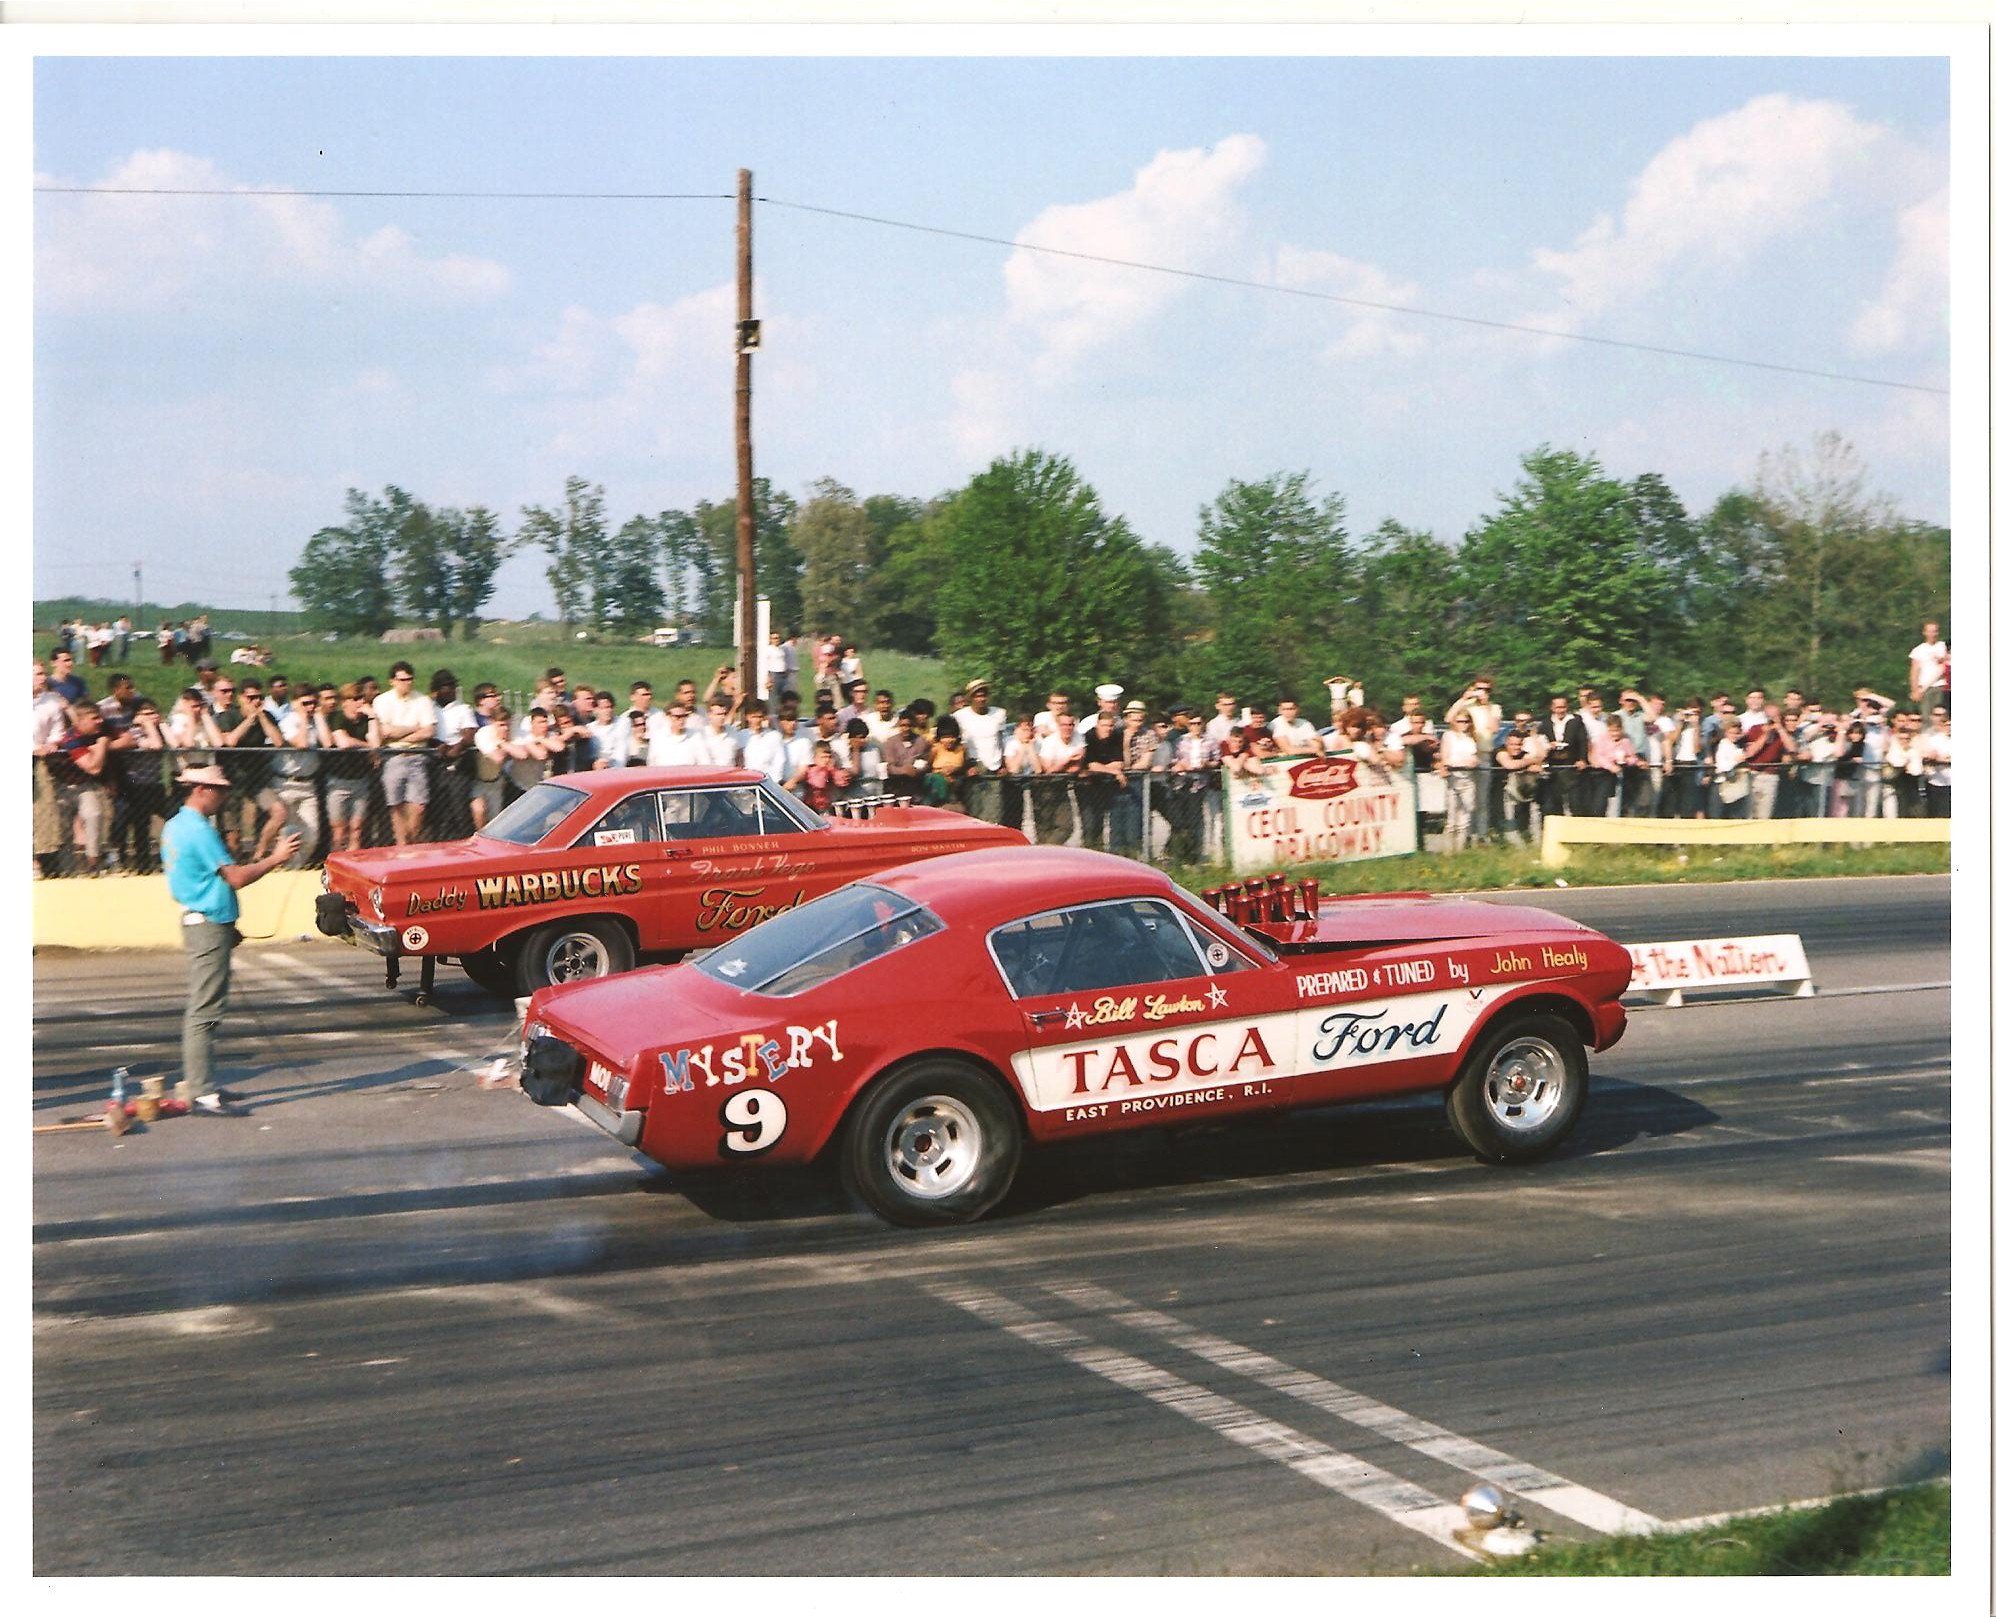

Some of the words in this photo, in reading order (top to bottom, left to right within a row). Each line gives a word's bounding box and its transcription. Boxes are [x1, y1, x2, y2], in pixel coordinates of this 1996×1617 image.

[1247, 807, 1302, 840] CECIL
[1324, 793, 1401, 829] COUNTY
[690, 857, 764, 882] Frank
[702, 845, 725, 855] PHIL
[733, 841, 780, 852] BONNER
[407, 885, 468, 917] Daddy
[475, 863, 643, 910] WARBUCKS
[1296, 968, 1368, 998] PREPARED
[1382, 960, 1435, 987] TUNED
[1447, 957, 1470, 983] by
[1490, 951, 1532, 974] John
[1542, 945, 1588, 970] Healy
[1648, 948, 1689, 978] the
[1085, 996, 1138, 1026] Bill
[1144, 994, 1205, 1021] Lawton
[658, 1019, 845, 1095] MYSTERY
[1063, 1027, 1276, 1094] TASCA
[1312, 1003, 1449, 1061] Ford
[719, 1088, 788, 1157] 9
[1066, 1104, 1108, 1122] EAST
[1244, 1083, 1272, 1097] R.I.
